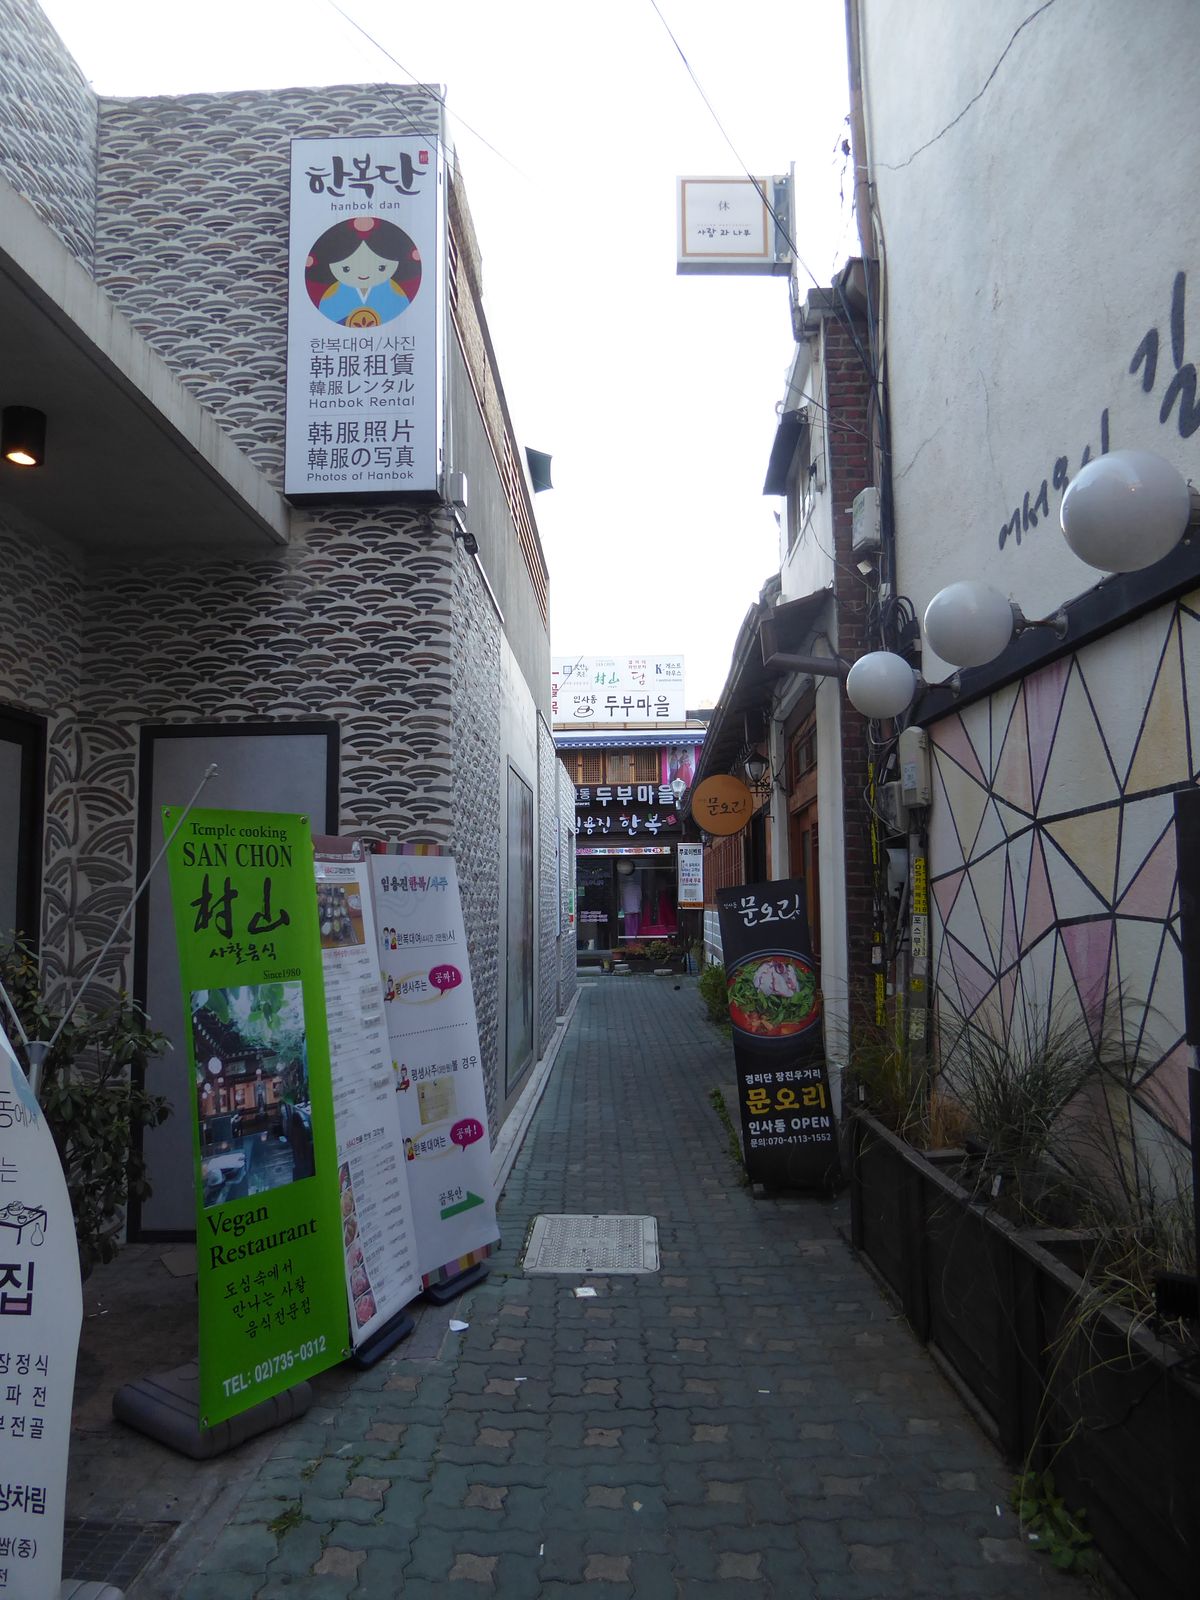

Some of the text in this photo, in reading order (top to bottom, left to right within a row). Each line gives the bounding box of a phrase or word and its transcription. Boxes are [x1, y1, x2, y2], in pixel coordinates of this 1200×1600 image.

[305, 152, 427, 199] 한복단
[330, 201, 400, 211] hanbok dan
[309, 336, 416, 354] 한복대여/사진
[309, 378, 415, 396] 韓服レンタル
[309, 396, 415, 409] Hanbok Rental
[307, 419, 415, 445] 韩服照片
[307, 445, 415, 471] 韓服の写真
[307, 471, 414, 482] Photos of Hanbok
[573, 695, 670, 718] 인사동 두부마을
[596, 785, 675, 807] 두부마을
[190, 822, 288, 842] Temple cooking
[183, 842, 293, 868] SAN CHON
[738, 894, 799, 927] 문오리
[209, 942, 277, 965] 사찰음식
[745, 1069, 821, 1085] 경리단 장진우거리
[745, 1082, 827, 1115] 문오리
[748, 1116, 831, 1135] 인사동 OPEN
[206, 1205, 270, 1238] Vegan
[209, 1218, 318, 1270] Restaurant
[232, 1275, 307, 1319] 만나는 사찰
[223, 1335, 327, 1398] TEL: 02)735-0312
